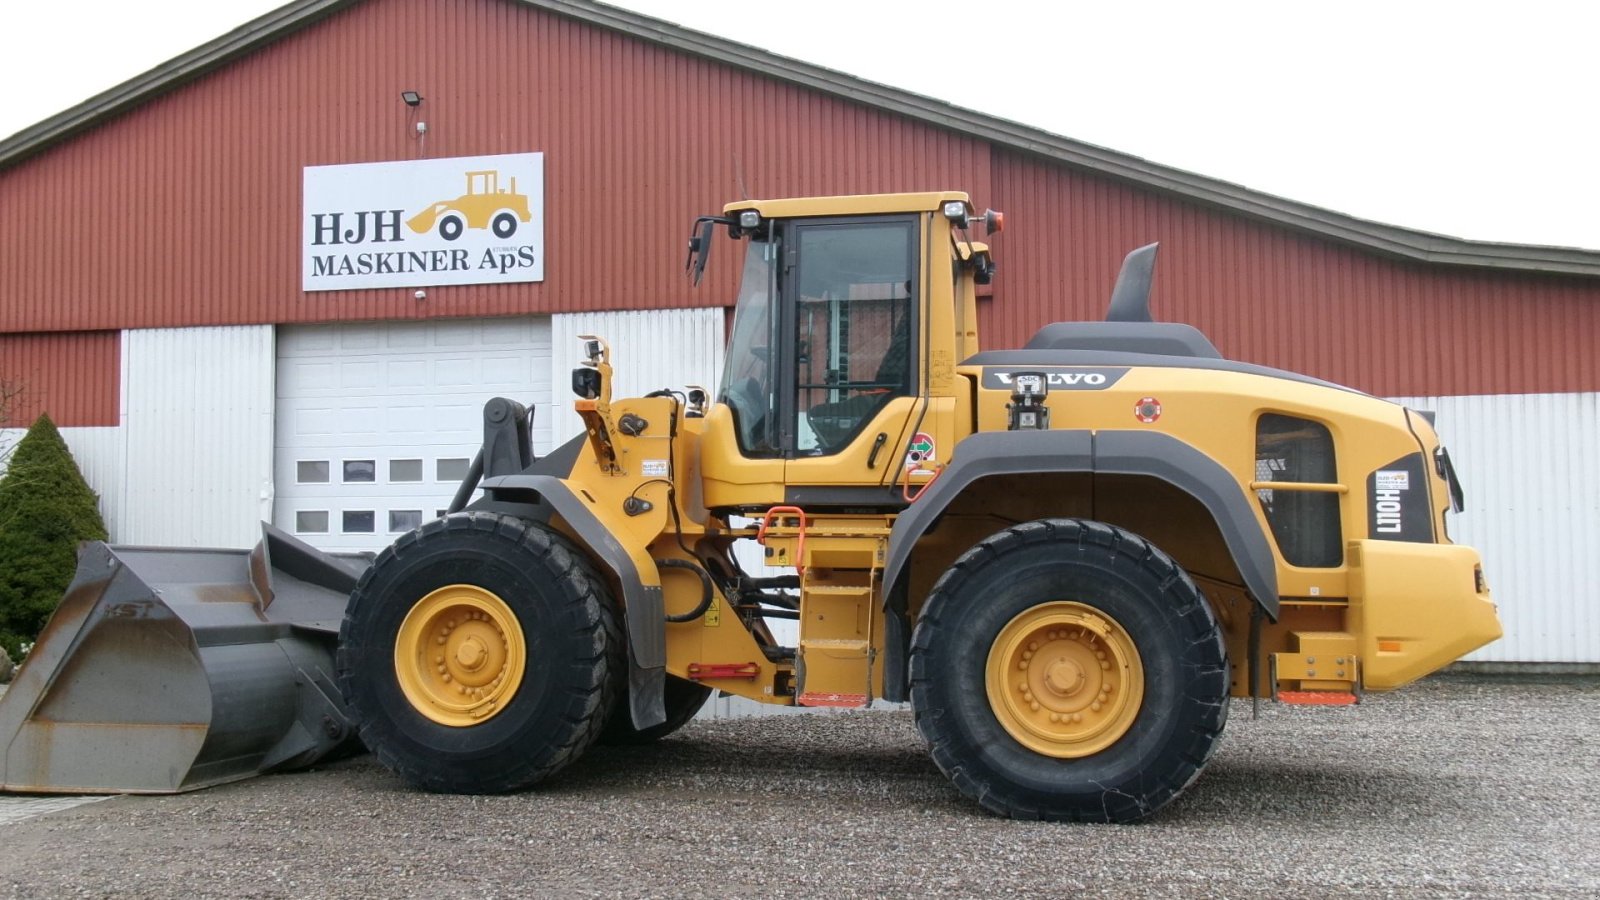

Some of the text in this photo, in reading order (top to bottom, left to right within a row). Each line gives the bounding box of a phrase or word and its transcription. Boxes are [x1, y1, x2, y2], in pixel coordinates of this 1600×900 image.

[311, 209, 405, 246] HJH
[311, 245, 535, 277] MASKINER ApS
[994, 372, 1107, 385] VLVO
[1375, 489, 1401, 533] L110H
